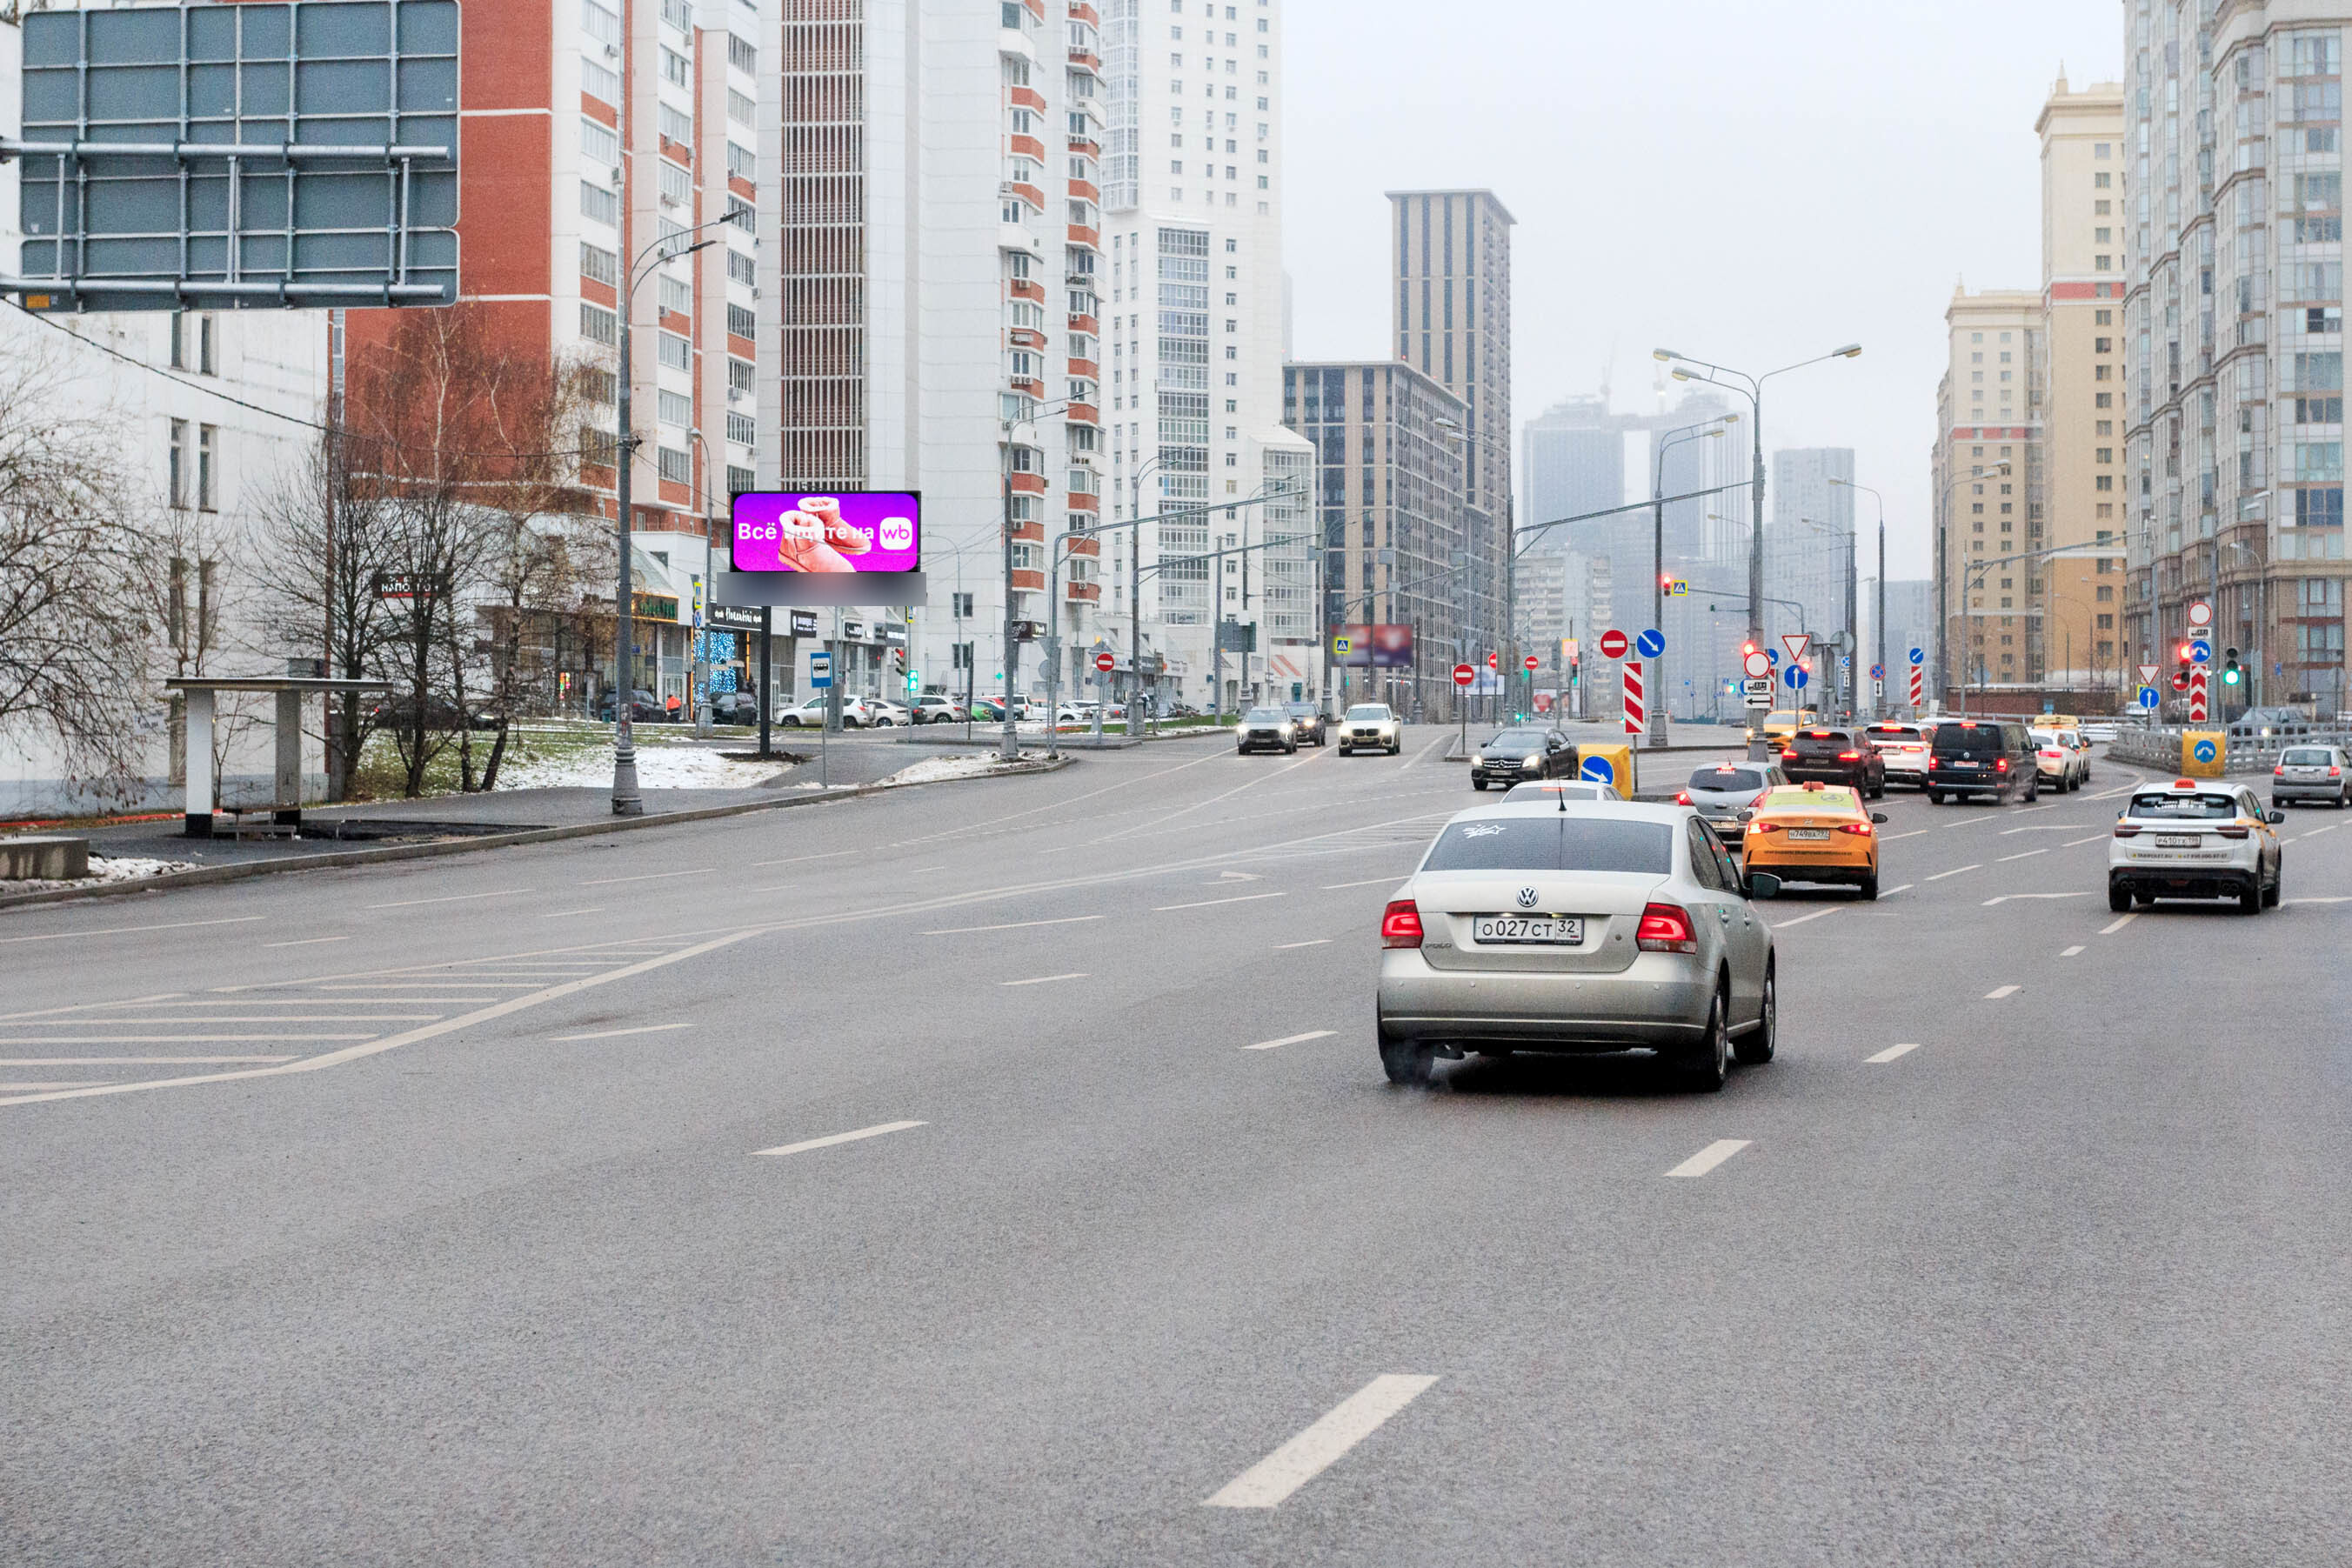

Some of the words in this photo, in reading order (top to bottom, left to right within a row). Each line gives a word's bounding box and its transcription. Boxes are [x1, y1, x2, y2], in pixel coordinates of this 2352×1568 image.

[738, 523, 777, 540] Всё
[784, 526, 847, 544] щте
[852, 527, 874, 540] на
[883, 524, 910, 539] wb
[382, 583, 438, 592] НАПОО
[1558, 919, 1575, 933] 32
